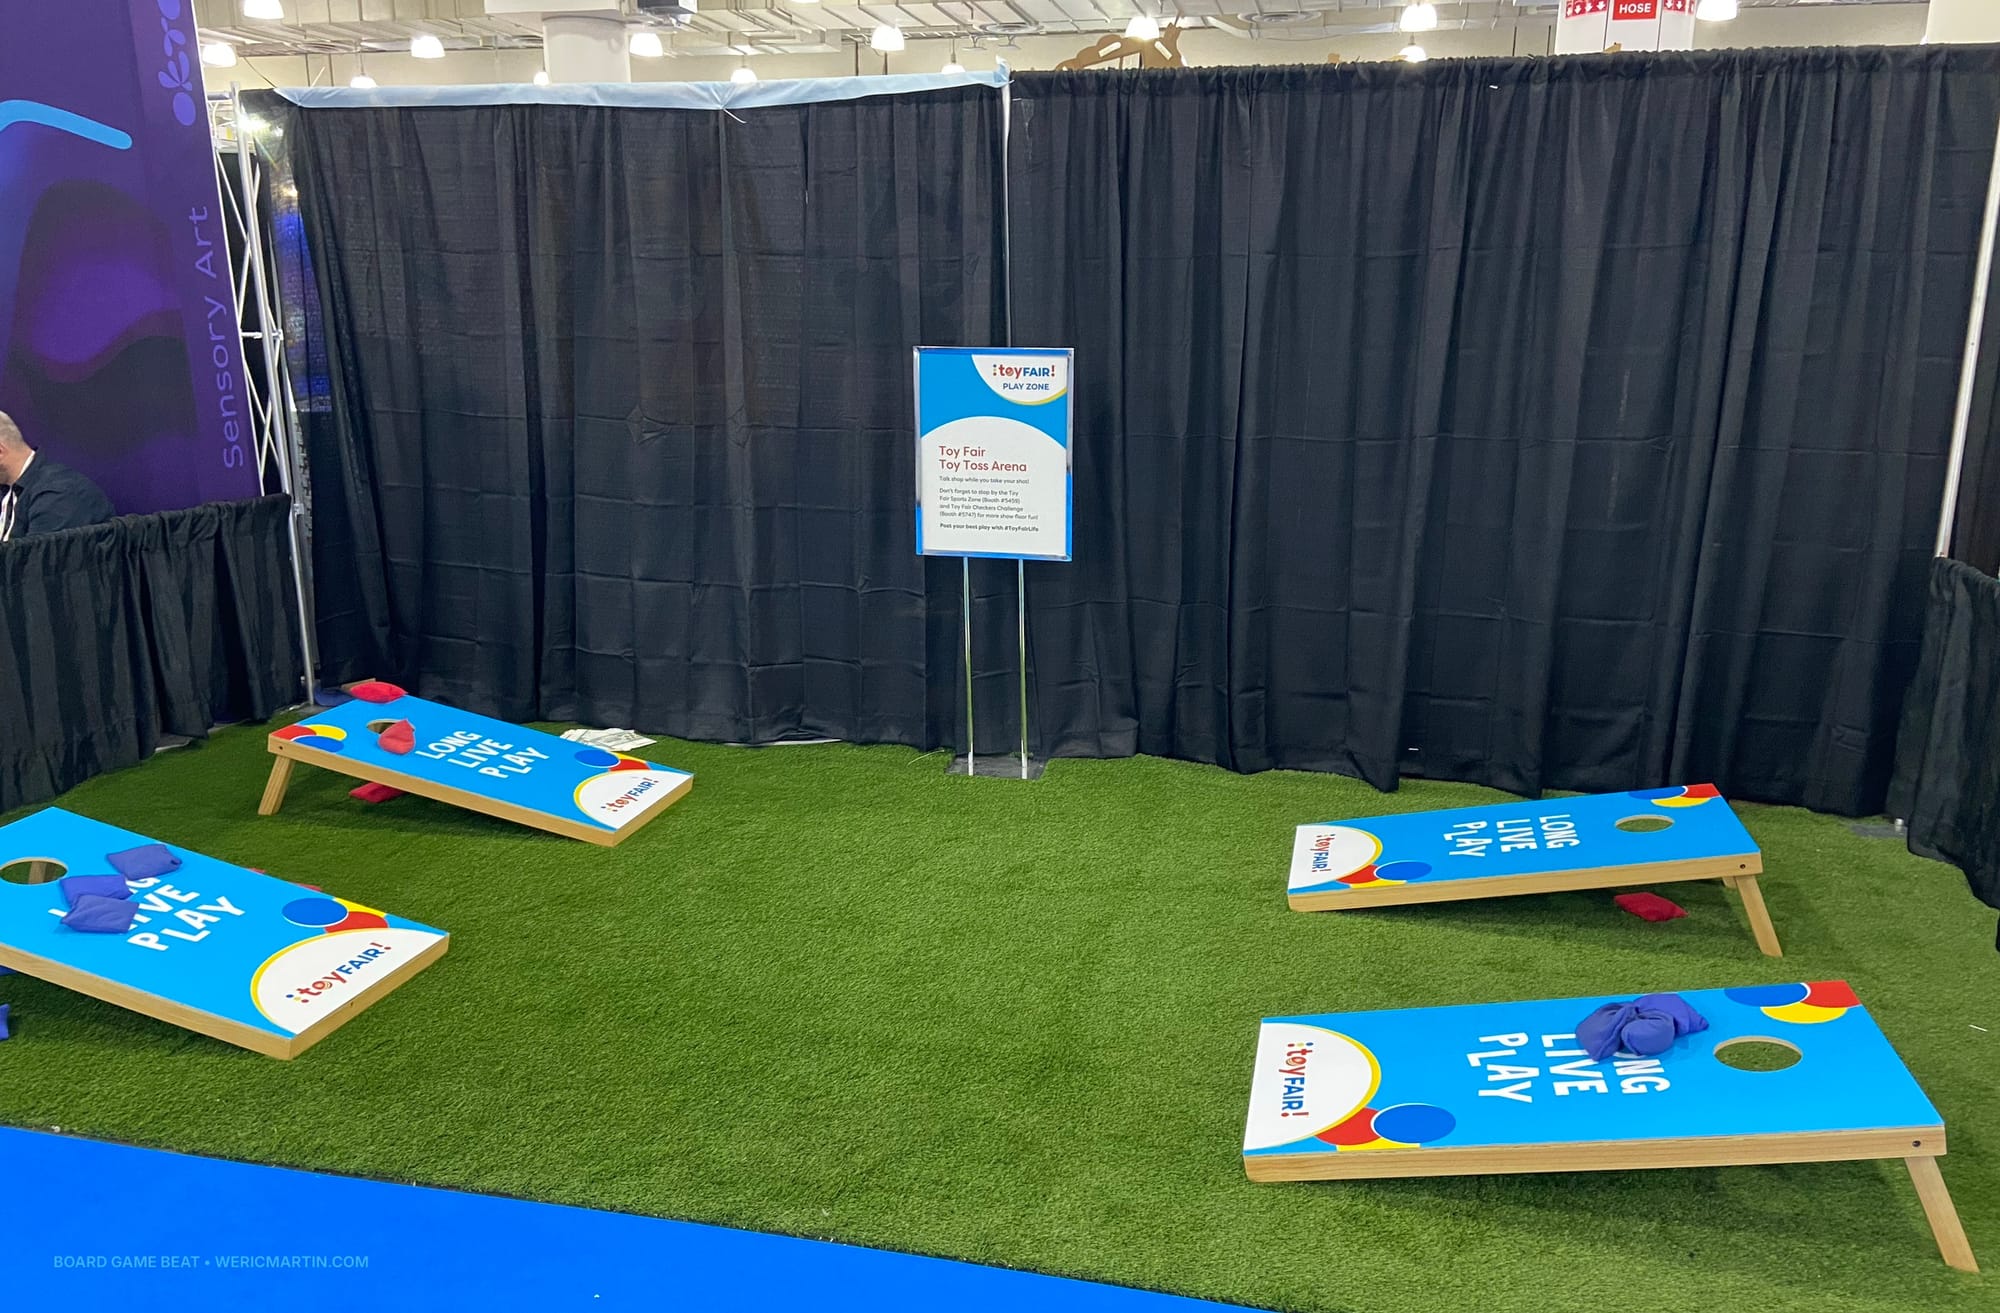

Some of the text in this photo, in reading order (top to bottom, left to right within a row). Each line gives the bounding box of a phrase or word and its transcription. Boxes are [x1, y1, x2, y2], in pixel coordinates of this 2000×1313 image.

[1619, 3, 1652, 14] HOSE
[189, 206, 243, 468] Sensory Art
[939, 446, 985, 458] Toy Fair
[939, 460, 1027, 472] Toy Toss Arena
[414, 731, 482, 759] LONG
[448, 738, 514, 768] LIVE
[478, 747, 550, 778] PLAY
[1443, 820, 1493, 856] PLAY
[1496, 819, 1538, 852] LIVE
[1539, 814, 1580, 848] LONG
[127, 896, 245, 951] PLAY
[1466, 1032, 1540, 1103] PLAY
[1541, 1034, 1608, 1096] LIVE
